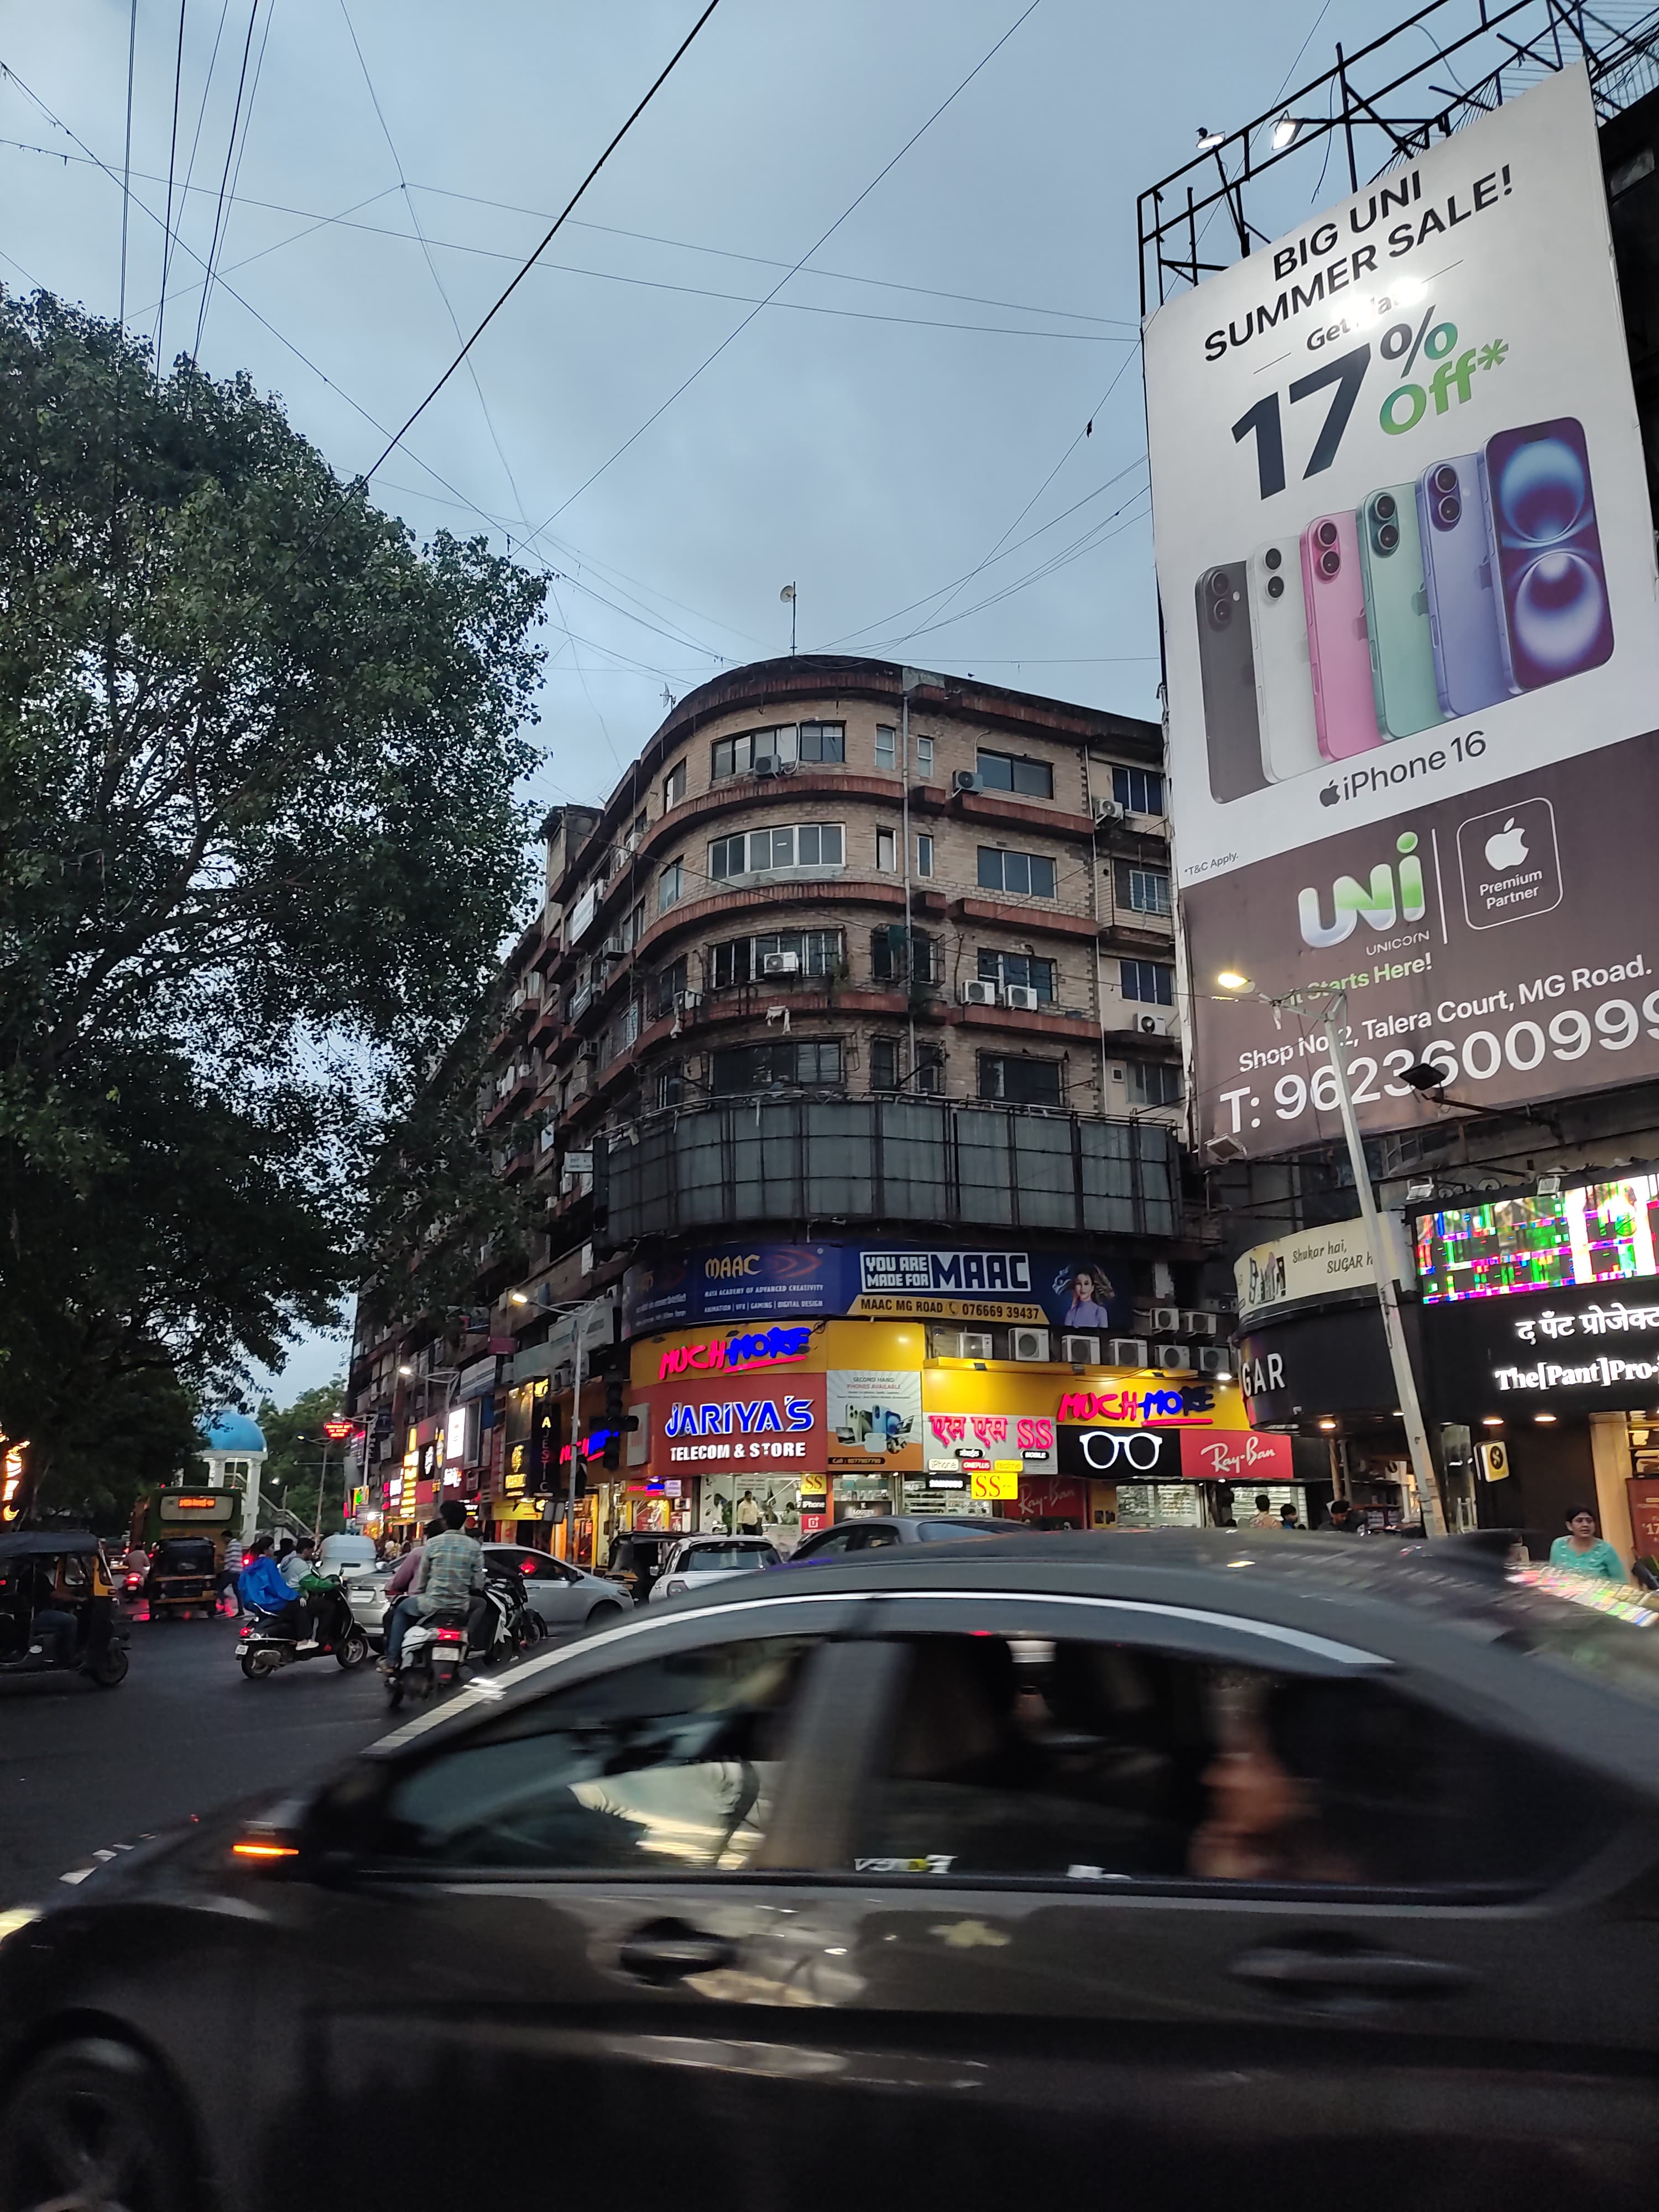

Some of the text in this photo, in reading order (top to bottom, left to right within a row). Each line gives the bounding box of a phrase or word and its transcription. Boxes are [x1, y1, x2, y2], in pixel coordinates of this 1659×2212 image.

[1273, 170, 1422, 283] BIG UNI
[1204, 163, 1514, 363] SUMMER SALE!
[1307, 317, 1350, 351] Get
[1343, 729, 1487, 801] iPhone 16
[1209, 852, 1239, 869] Apply.
[1479, 869, 1543, 898] Premium
[1485, 886, 1540, 911] Partner
[1366, 930, 1431, 956] UNICORN
[1307, 972, 1370, 1001] Starts
[1374, 952, 1433, 984] Here!
[1239, 1044, 1295, 1073] Shop
[1361, 1011, 1433, 1041] Talera
[1437, 989, 1515, 1023] Court,
[1517, 974, 1566, 1005] MG
[1571, 954, 1653, 993] Road.
[1220, 1086, 1261, 1134] T:
[865, 1256, 928, 1272] YOU ARE
[1292, 1244, 1326, 1264] Shukar
[1327, 1254, 1364, 1274] SUGAR
[705, 1254, 763, 1280] MAAC
[931, 1254, 1029, 1290] MAAC
[719, 1288, 744, 1296] ACADEMY
[755, 1285, 787, 1293] ADVANCED
[867, 1273, 929, 1287] MADE FOR
[750, 1301, 773, 1310] GAMING
[860, 1298, 1039, 1319] MAAC MG ROAD 076669 39437
[664, 1395, 815, 1438] JARIYA'S
[928, 1415, 1008, 1448] एस एस
[1016, 1418, 1055, 1450] SS
[670, 1441, 807, 1462] TELECOM & STORE
[931, 1459, 957, 1469] iPhone
[804, 1475, 823, 1490] SS
[975, 1474, 1001, 1498] SS
[802, 1500, 826, 1509] iPhone
